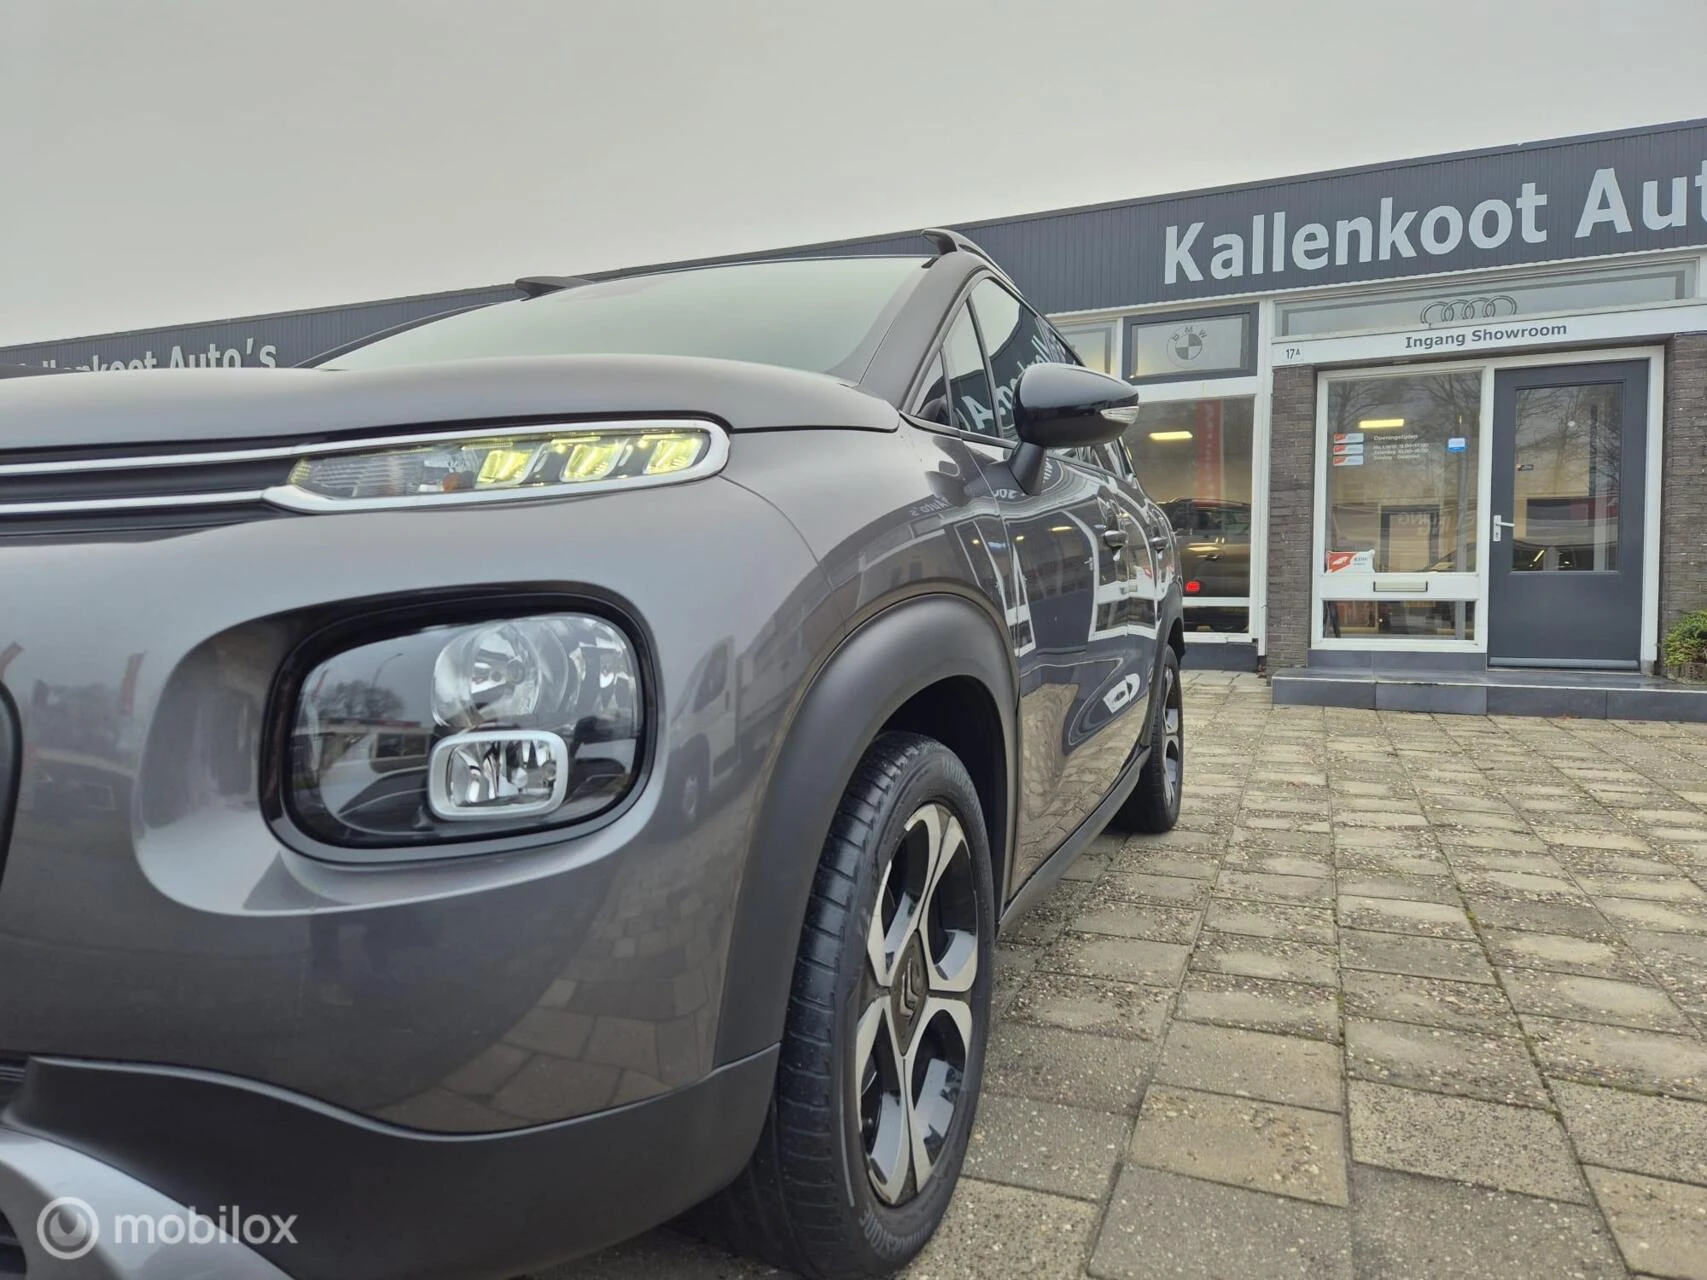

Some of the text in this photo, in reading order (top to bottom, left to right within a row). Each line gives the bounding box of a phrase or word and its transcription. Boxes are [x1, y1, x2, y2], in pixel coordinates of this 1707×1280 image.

[1164, 182, 1547, 284] Kallenkoot
[1405, 324, 1567, 349] Ingang Showroom
